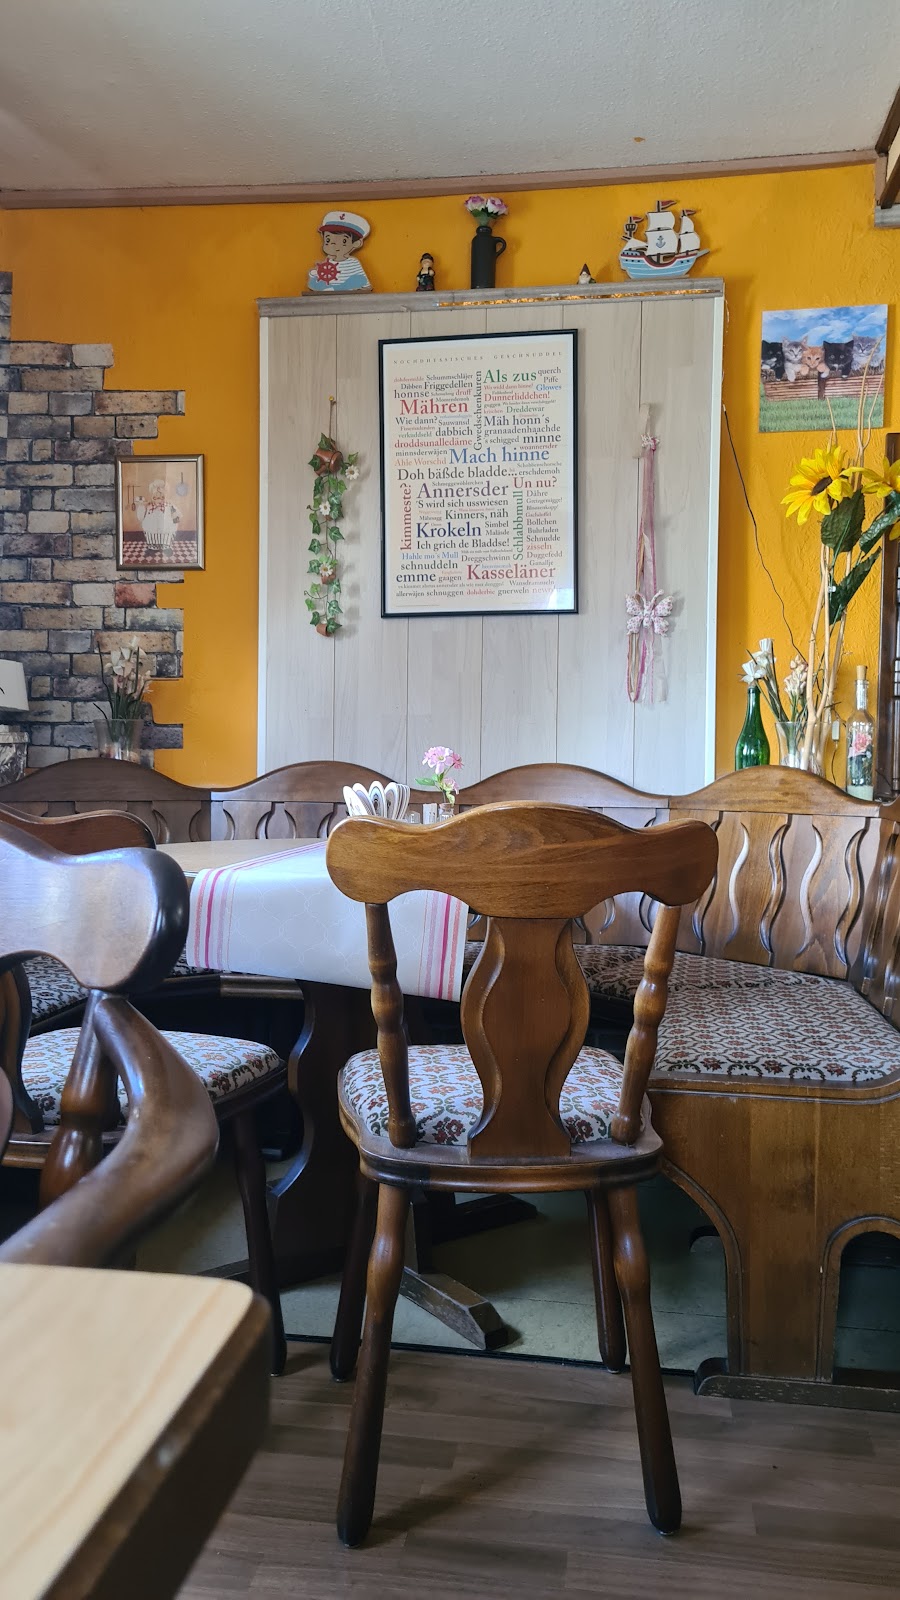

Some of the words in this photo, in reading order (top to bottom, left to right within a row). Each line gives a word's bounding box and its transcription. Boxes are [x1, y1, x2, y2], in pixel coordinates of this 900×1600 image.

[483, 369, 508, 383] Als
[512, 371, 537, 382] zus
[537, 367, 562, 376] querch
[424, 380, 473, 391] Friggedellen
[394, 389, 430, 398] honnse
[484, 391, 550, 402] Dunnerliddchen!
[400, 398, 469, 415] Mähren
[473, 370, 482, 450] Gwedschenkuren
[395, 417, 412, 425] Wie
[414, 416, 438, 425] dann?
[484, 415, 510, 426] Mäh
[435, 427, 473, 437] dabbich
[484, 424, 561, 436] granaadenhaachde
[394, 438, 473, 448] droddsunalledäme
[489, 436, 520, 445] schigged
[523, 433, 562, 443] minne
[395, 449, 448, 457] minnsderwäjen
[449, 447, 498, 464] Mach
[502, 446, 550, 462] hinne
[414, 457, 447, 466] Worschd
[397, 468, 424, 480] Doh
[428, 467, 465, 479] bäßde
[518, 467, 561, 476] erschdemoh
[513, 477, 532, 488] Un
[536, 476, 557, 488] nu?
[416, 481, 509, 498] Annersder
[425, 499, 445, 508] wird
[447, 499, 464, 507] sich
[466, 499, 509, 507] usswiesen
[400, 482, 412, 550] kimmeste?
[445, 510, 488, 520] Kinners,
[490, 508, 509, 518] näh
[485, 520, 509, 528] Simbel
[513, 490, 523, 560] Schlabbmull
[526, 518, 557, 526] Bollchen
[416, 521, 482, 538] Krokeln
[526, 533, 560, 542] Schnudde
[417, 540, 431, 549] Ich
[433, 540, 456, 551] grich
[458, 540, 469, 548] de
[472, 538, 510, 548] Bladdse!
[526, 542, 552, 550] zisseln
[461, 554, 510, 563] Dreggschwinn
[526, 551, 563, 560] Duggefedd
[400, 560, 458, 570] schnuddeln
[466, 563, 556, 580] Kasseläner
[396, 573, 437, 583] emme
[438, 575, 462, 583] gaagen
[426, 589, 464, 597] schnuggen
[497, 587, 529, 596] gnerweln
